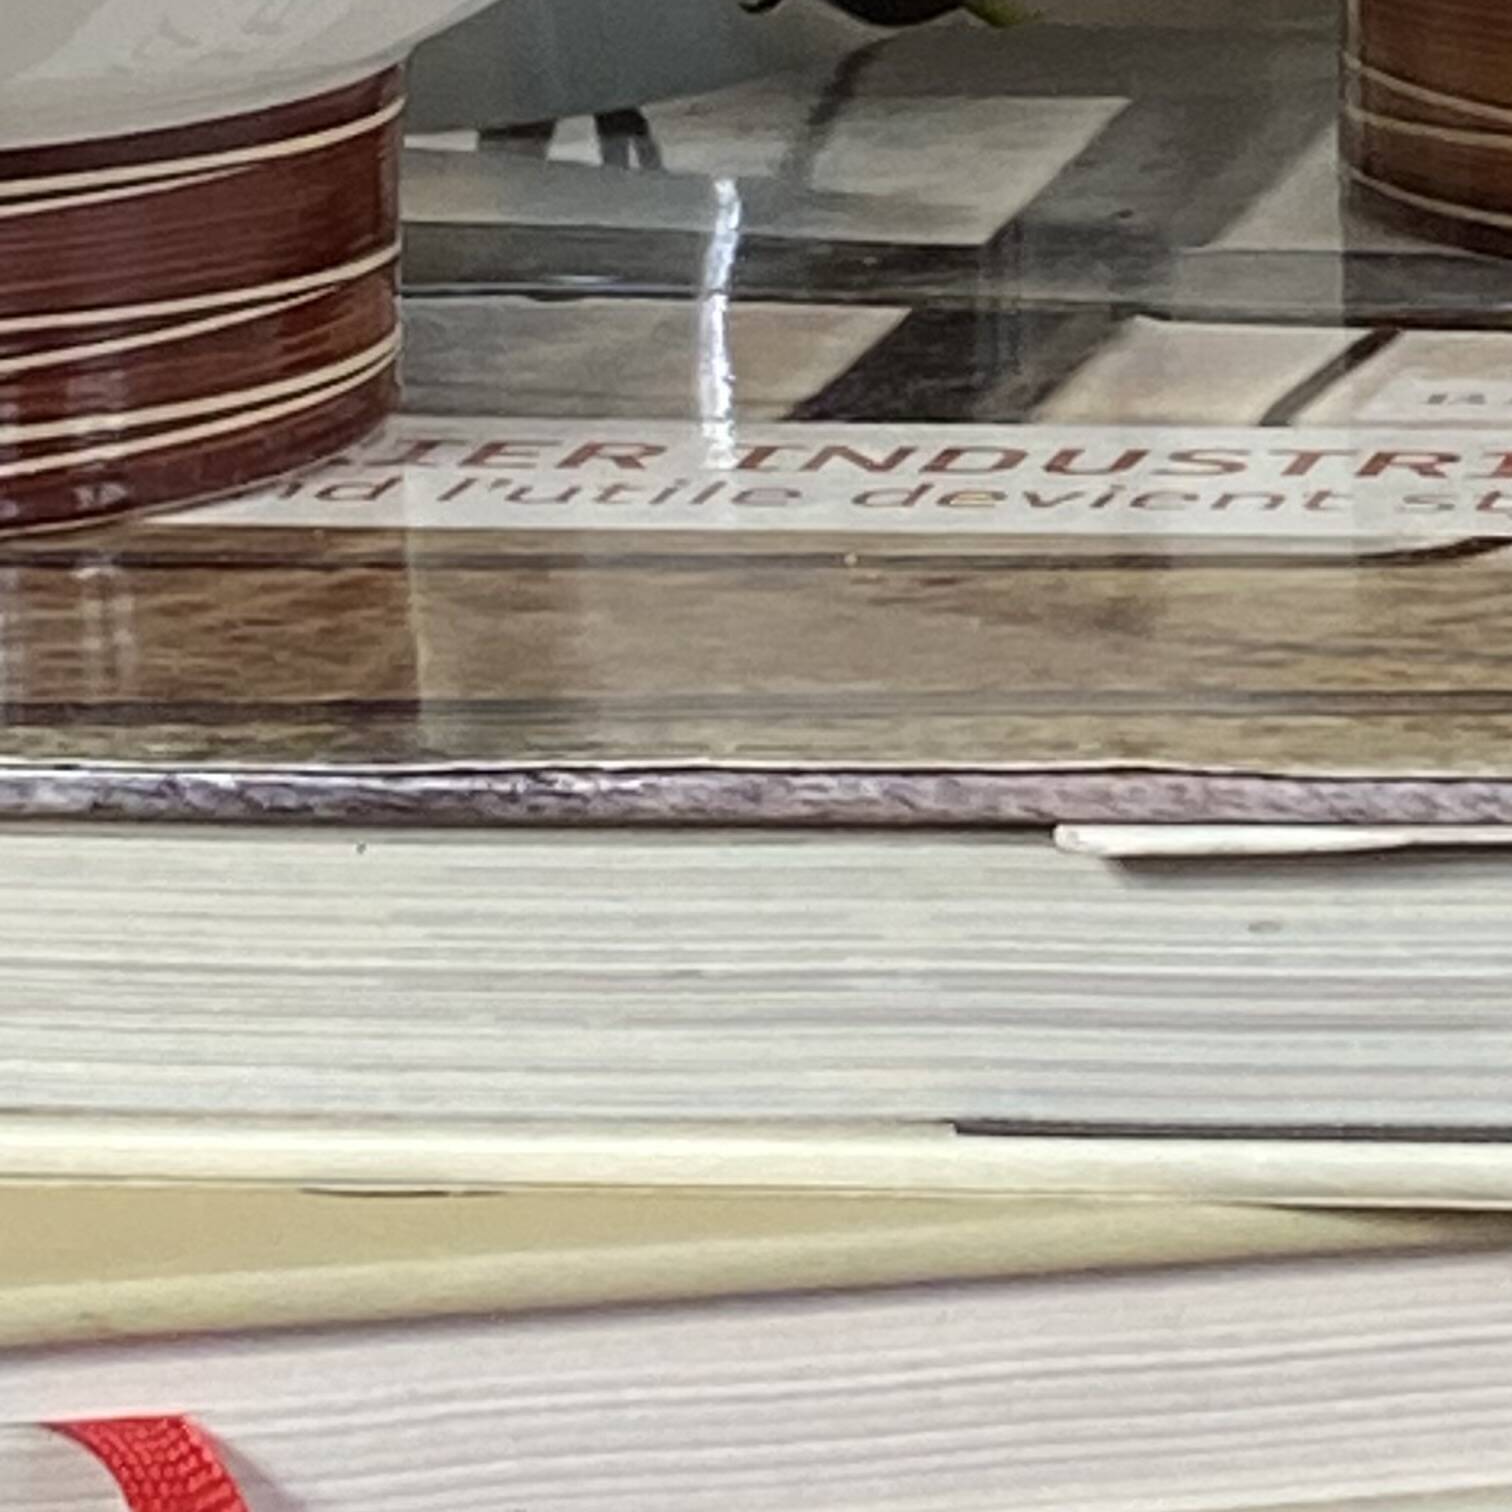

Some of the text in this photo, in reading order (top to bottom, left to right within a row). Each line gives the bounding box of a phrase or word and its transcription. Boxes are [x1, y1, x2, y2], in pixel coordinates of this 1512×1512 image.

[326, 438, 668, 469] IER
[437, 477, 801, 505] l'utile
[852, 483, 1348, 510] devient
